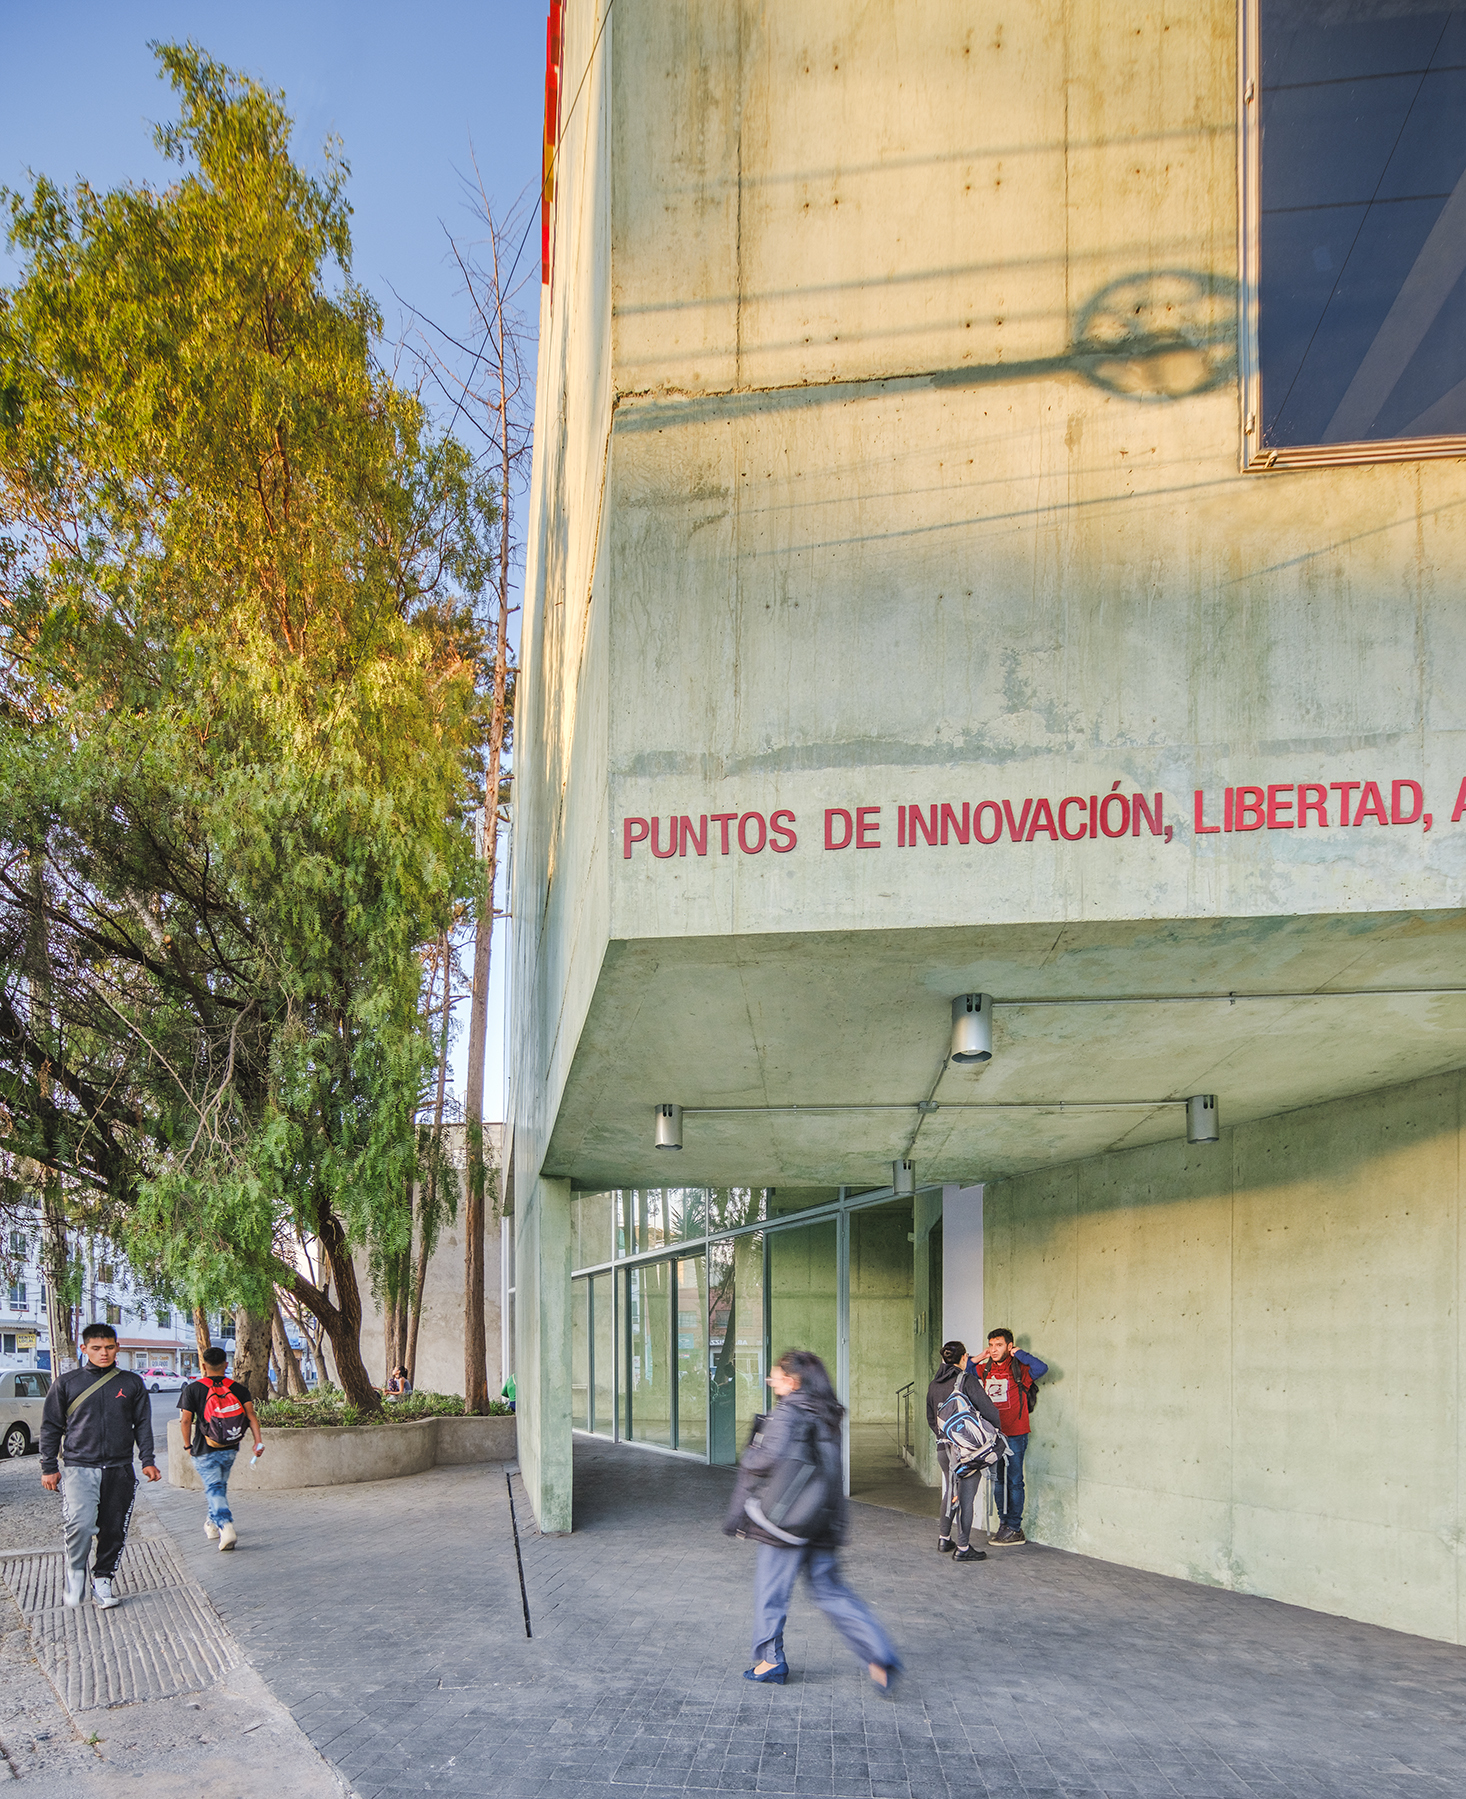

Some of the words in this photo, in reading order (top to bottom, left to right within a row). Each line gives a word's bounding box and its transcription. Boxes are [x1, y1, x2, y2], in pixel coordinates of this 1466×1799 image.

[623, 808, 797, 859] PUNTOS
[824, 805, 881, 849] DE
[897, 780, 1173, 846] INNOVACIÓN,
[1194, 779, 1433, 833] LIBERTAD,
